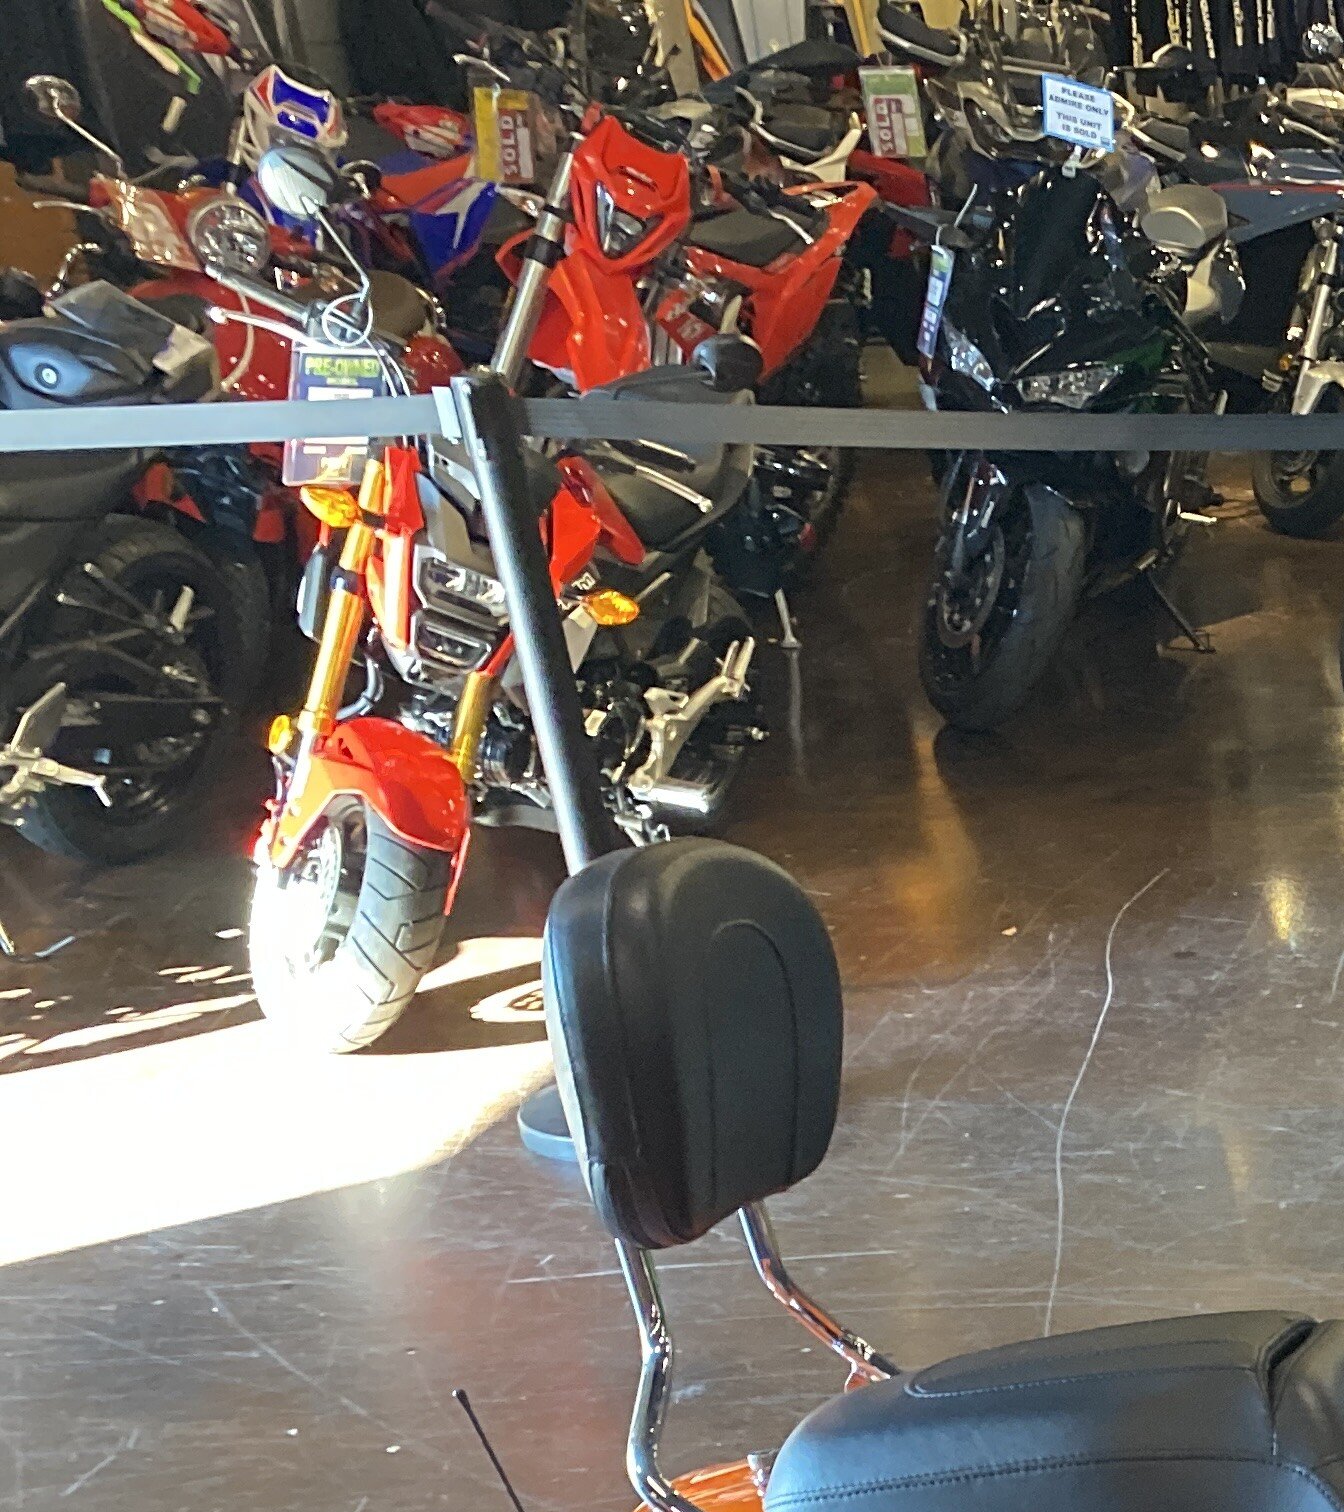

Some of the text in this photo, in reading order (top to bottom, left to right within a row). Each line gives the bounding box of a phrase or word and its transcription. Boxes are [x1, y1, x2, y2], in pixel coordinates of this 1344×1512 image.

[1048, 93, 1110, 117] ADMIRE ONLY
[1061, 86, 1096, 103] PLEASE
[875, 103, 894, 152] SOLD
[1055, 111, 1103, 132] THIS UNIT
[1061, 123, 1098, 140] IS SOLD
[500, 114, 519, 176] SOLD
